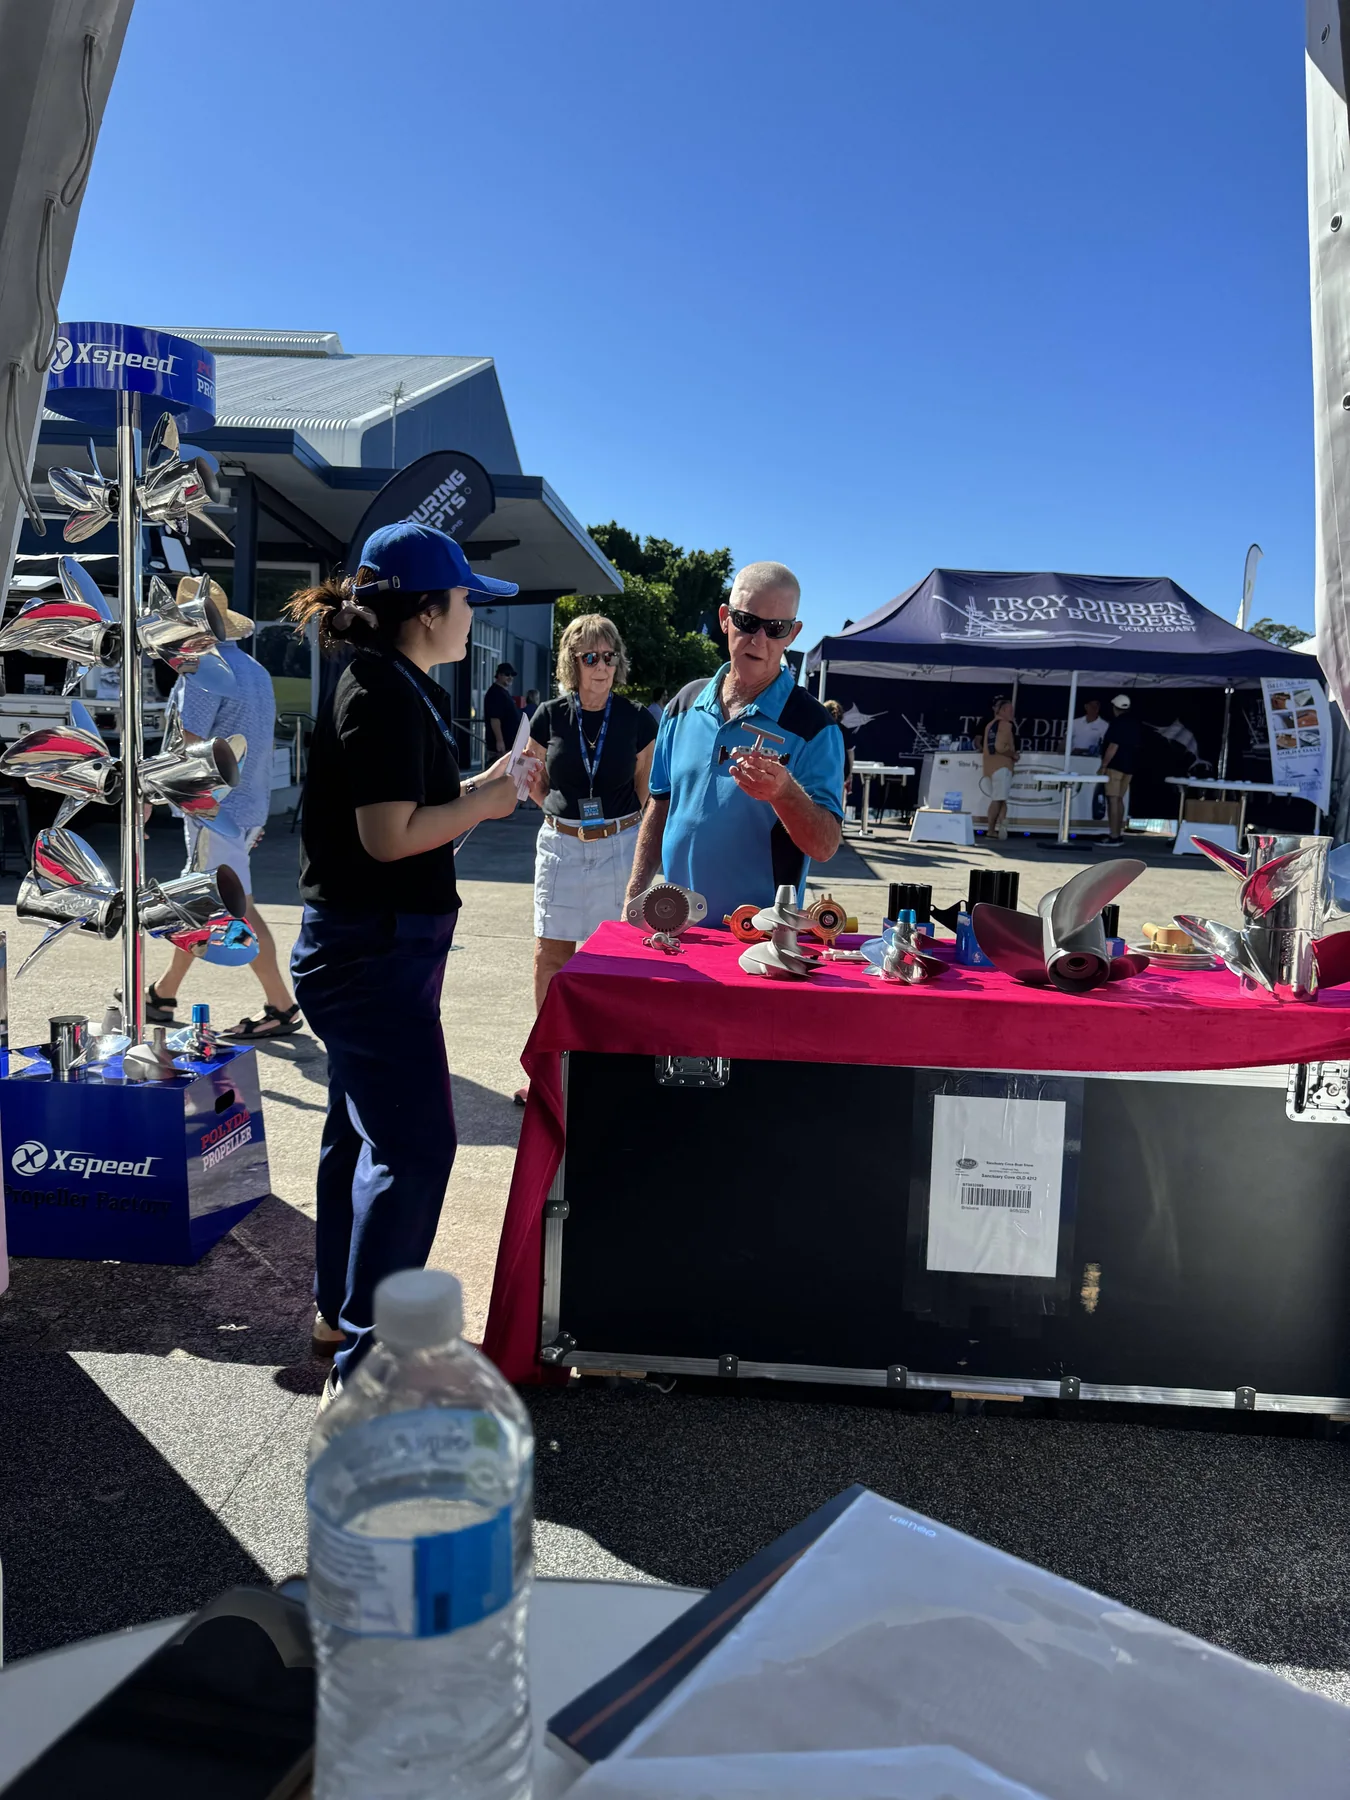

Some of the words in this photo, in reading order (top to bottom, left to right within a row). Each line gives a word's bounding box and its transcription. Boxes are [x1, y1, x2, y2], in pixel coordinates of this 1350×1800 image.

[74, 342, 183, 377] Xspeed
[987, 595, 1069, 611] TROY
[1076, 597, 1188, 616] DIBBEN
[991, 607, 1060, 622] BOAT
[1067, 607, 1195, 627] BUILDERS
[1119, 625, 1154, 633] GOLD
[200, 1108, 251, 1151] POLYDA
[202, 1126, 253, 1172] PROPELLER
[48, 1149, 163, 1179] Xspeed
[95, 1191, 173, 1218] Factory
